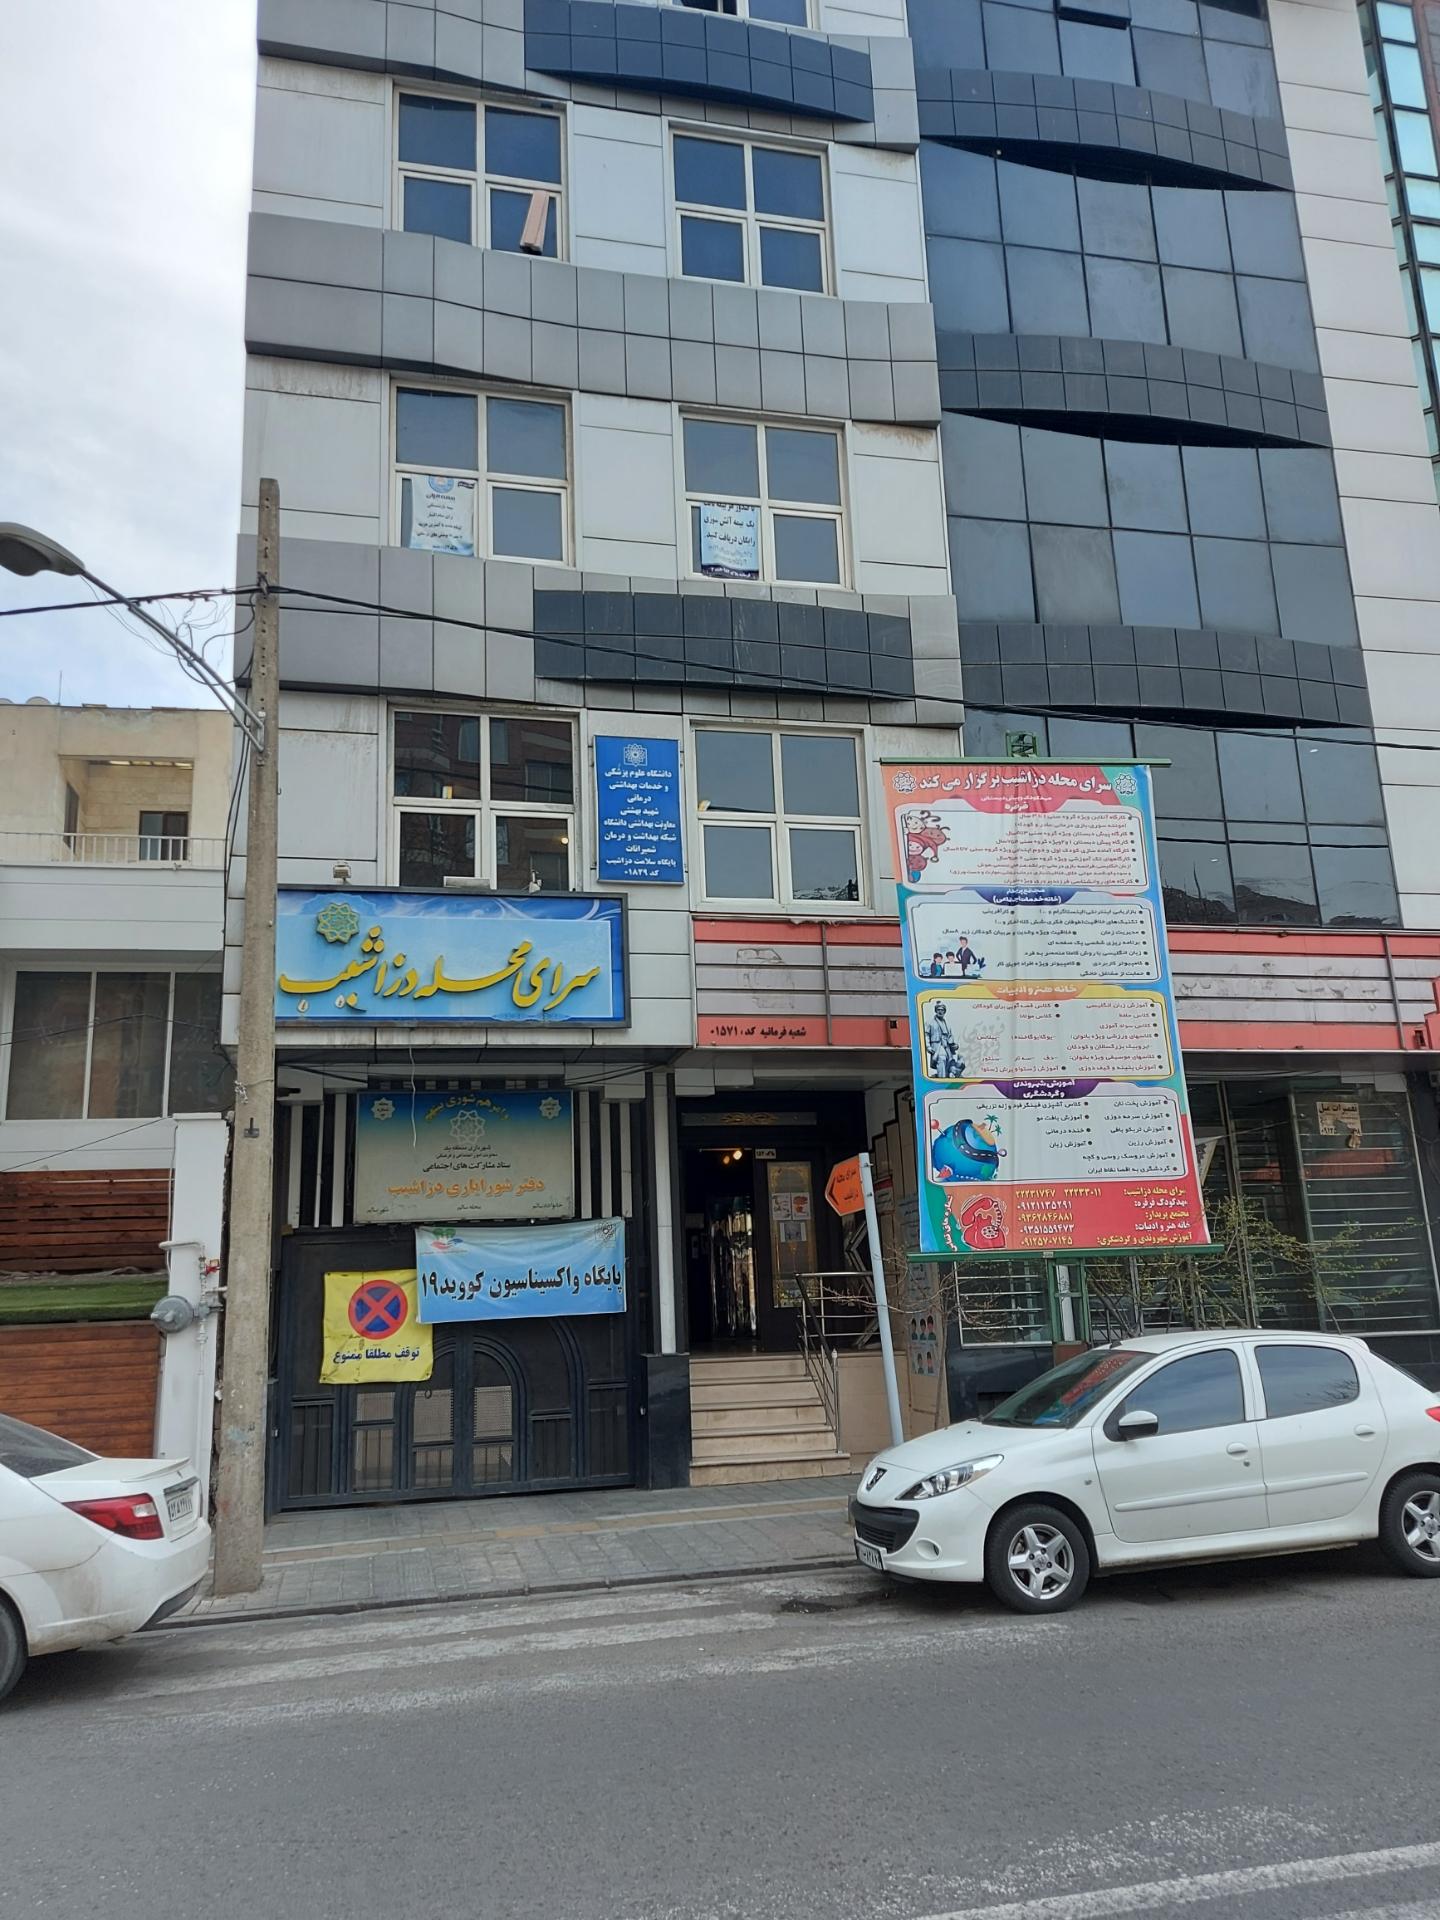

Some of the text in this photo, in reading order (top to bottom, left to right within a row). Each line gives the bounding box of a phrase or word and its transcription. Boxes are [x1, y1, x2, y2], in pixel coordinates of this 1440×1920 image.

[604, 767, 628, 778] پزشکی
[629, 770, 646, 780] علوم
[919, 774, 940, 789] کند
[1001, 770, 1046, 788] دزاشیب
[1048, 772, 1078, 787] محله
[608, 782, 638, 791] بهداشتی
[638, 782, 663, 790] خدمات
[942, 778, 961, 791] می
[1080, 776, 1112, 793] سرای
[626, 794, 652, 804] درمانی
[620, 806, 659, 816] شهید بهشتی
[1004, 802, 1029, 812] فرفره
[604, 818, 676, 830] معاونت بهداشتی دانشگاه
[604, 831, 626, 841] درمان
[632, 832, 659, 841] بهداشت
[660, 833, 677, 841] شبکه
[625, 844, 657, 855] شمیرانات
[606, 857, 632, 866] دزاشیب
[656, 860, 676, 868] پایگاه
[278, 924, 601, 1013] سرای محله دزاشیب
[996, 986, 1027, 996] ادبیات
[1034, 986, 1053, 996] هنر
[1054, 984, 1077, 993] خانه
[710, 1026, 738, 1037] ۰۱۵۷۱
[760, 1026, 787, 1040] فرمانیه
[790, 1026, 806, 1038] شعبه
[1013, 1080, 1075, 1088] آموزش شهروندی
[1023, 1090, 1060, 1098] گردشگری
[422, 1162, 452, 1172] اجتماعی
[469, 1162, 496, 1170] مشارکت
[385, 1176, 545, 1199] دفتر شورایاری دزاشیب
[1124, 1187, 1152, 1197] دزاشیب:
[1152, 1186, 1168, 1194] محله
[1134, 1198, 1156, 1208] فرفره:
[1145, 1210, 1189, 1220] مجتمع پریدار:
[1135, 1221, 1159, 1232] ادبیات:
[1165, 1222, 1176, 1231] هنر
[1177, 1221, 1191, 1229] خانه
[1097, 1235, 1130, 1246] گردشگری:
[1138, 1234, 1168, 1244] شهروندی
[1169, 1232, 1192, 1243] آموزش
[488, 1266, 581, 1298] واکسیناسیون
[584, 1264, 623, 1292] پایگاه
[332, 1346, 420, 1364] توقف مطلقا ممنوع
